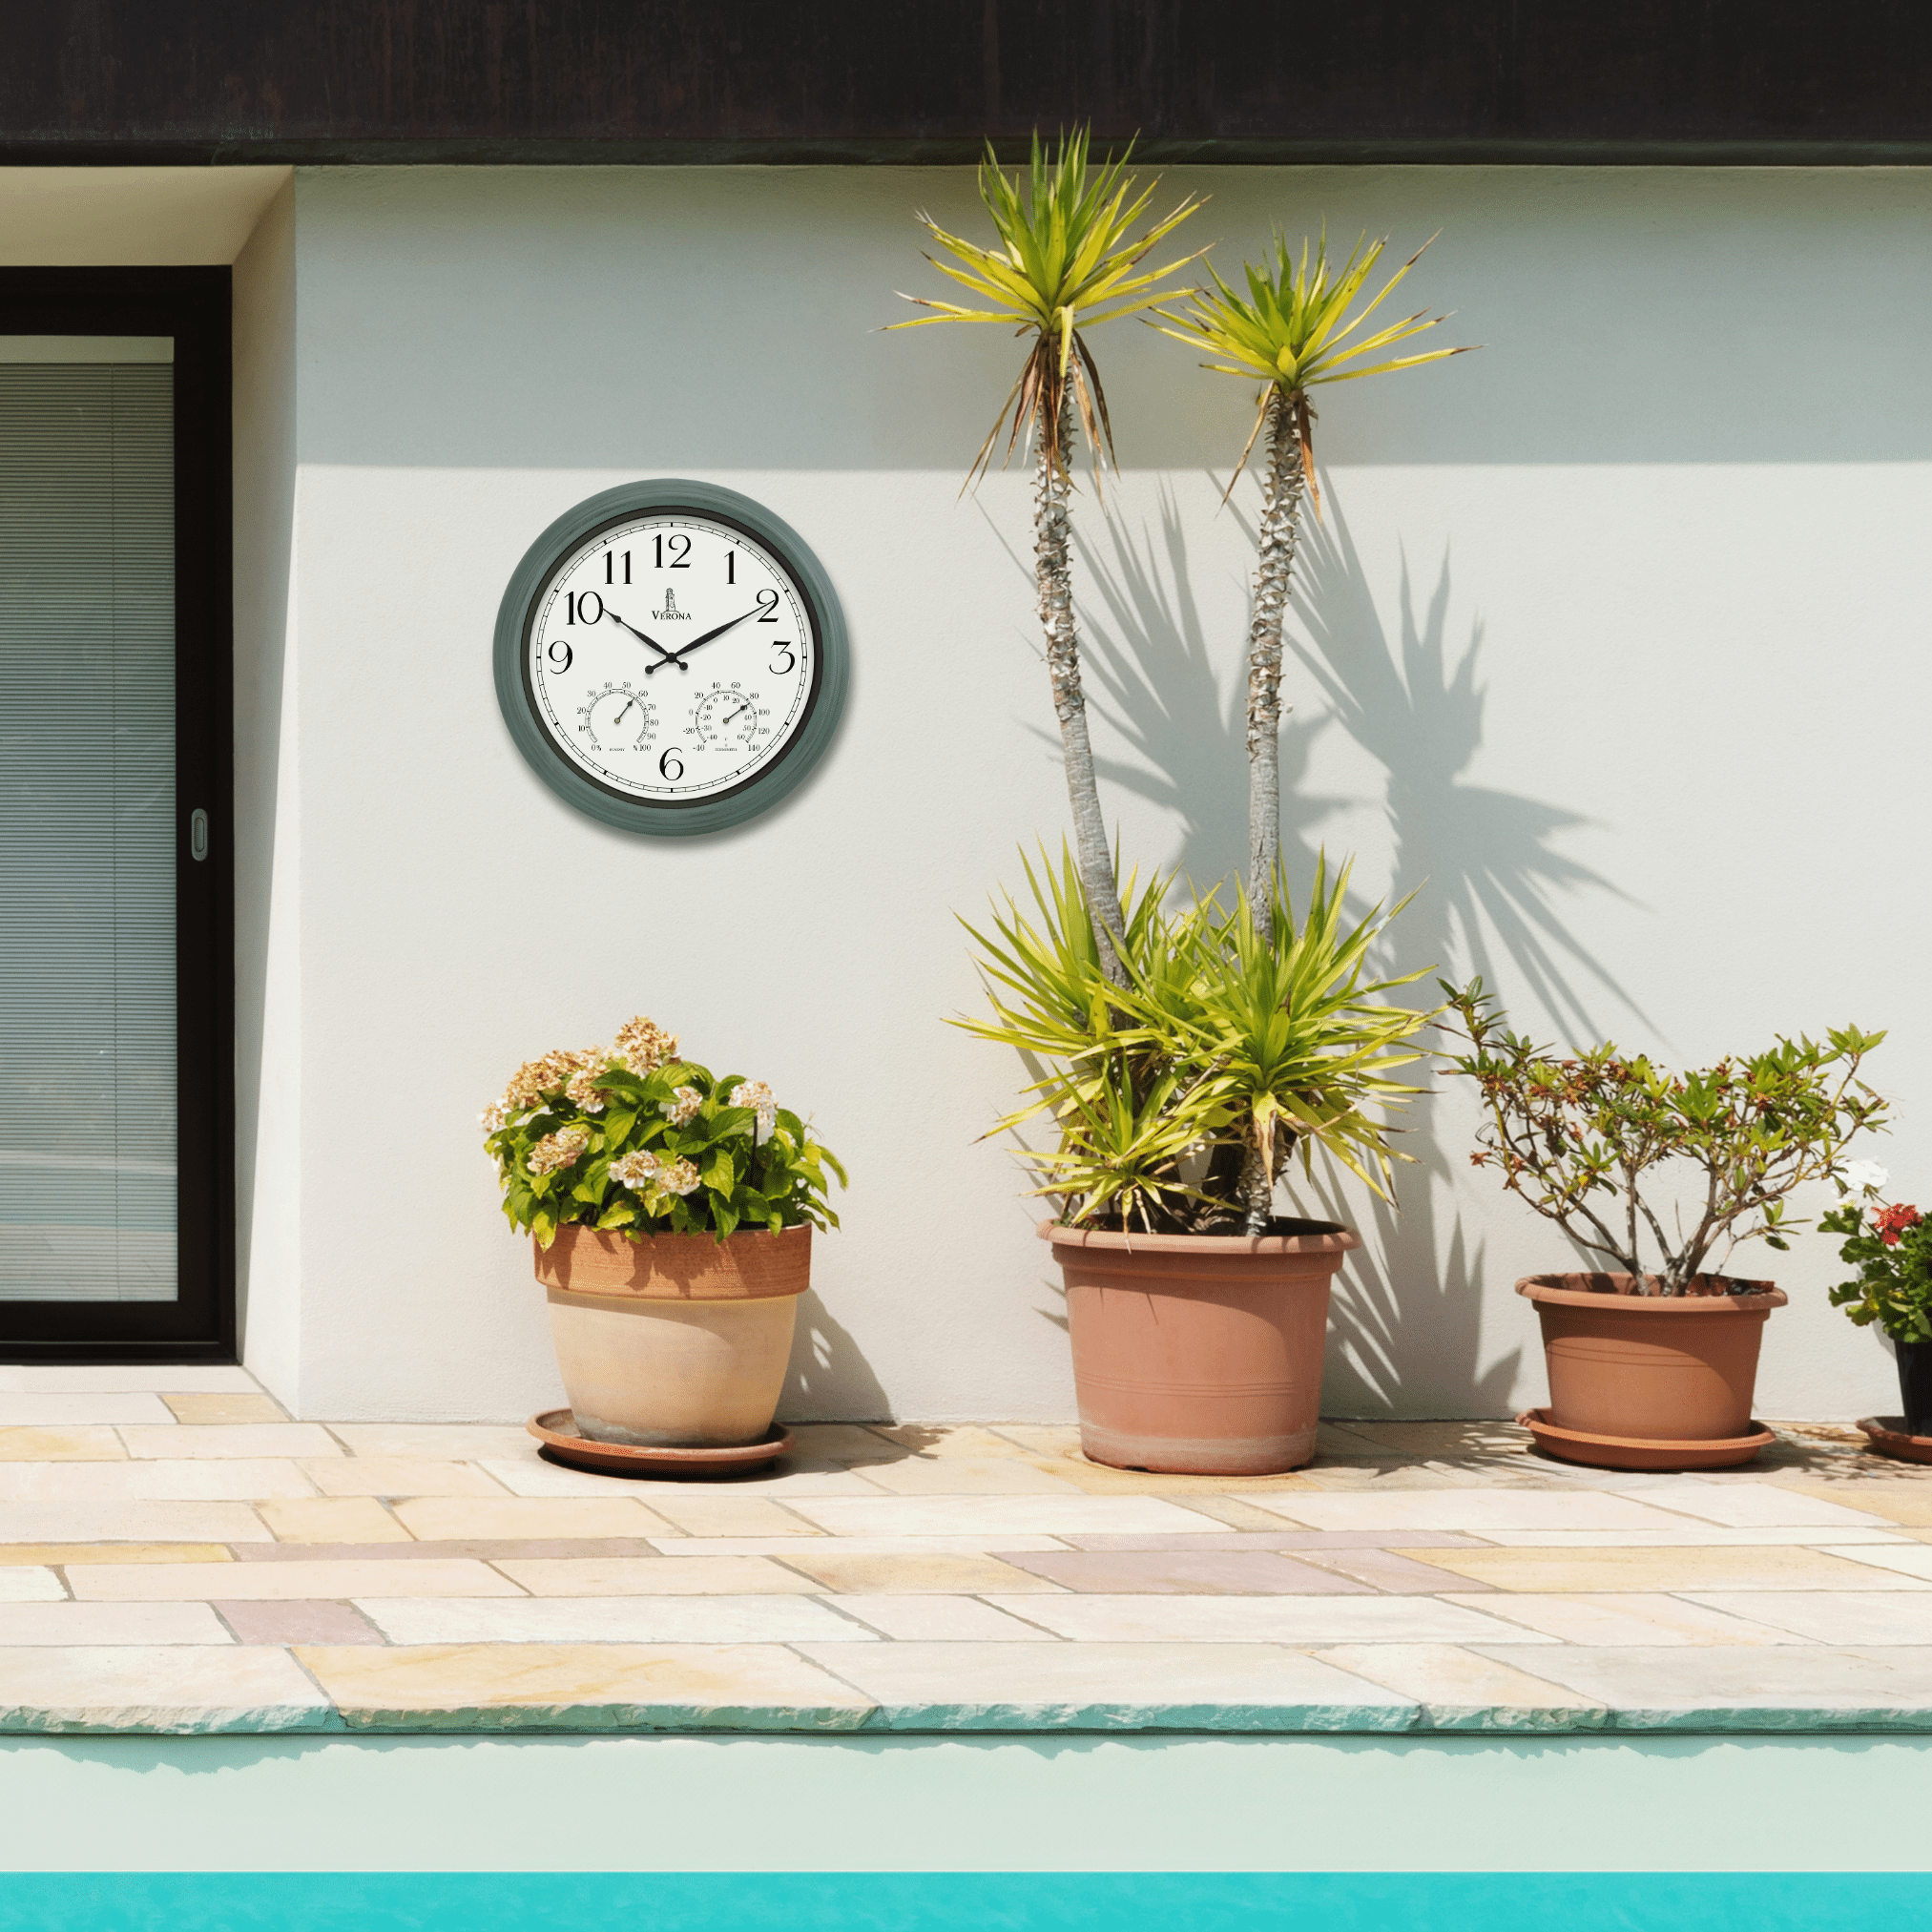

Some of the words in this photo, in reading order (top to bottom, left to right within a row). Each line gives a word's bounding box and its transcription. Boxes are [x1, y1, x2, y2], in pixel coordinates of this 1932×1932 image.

[602, 550, 633, 585] 11
[652, 533, 692, 569] 12
[724, 550, 737, 585] 1
[563, 591, 604, 626] 10
[651, 611, 692, 621] VERONA
[756, 588, 779, 623] 2
[548, 640, 573, 675] 9
[768, 640, 796, 675] 3
[658, 746, 685, 781] 6
